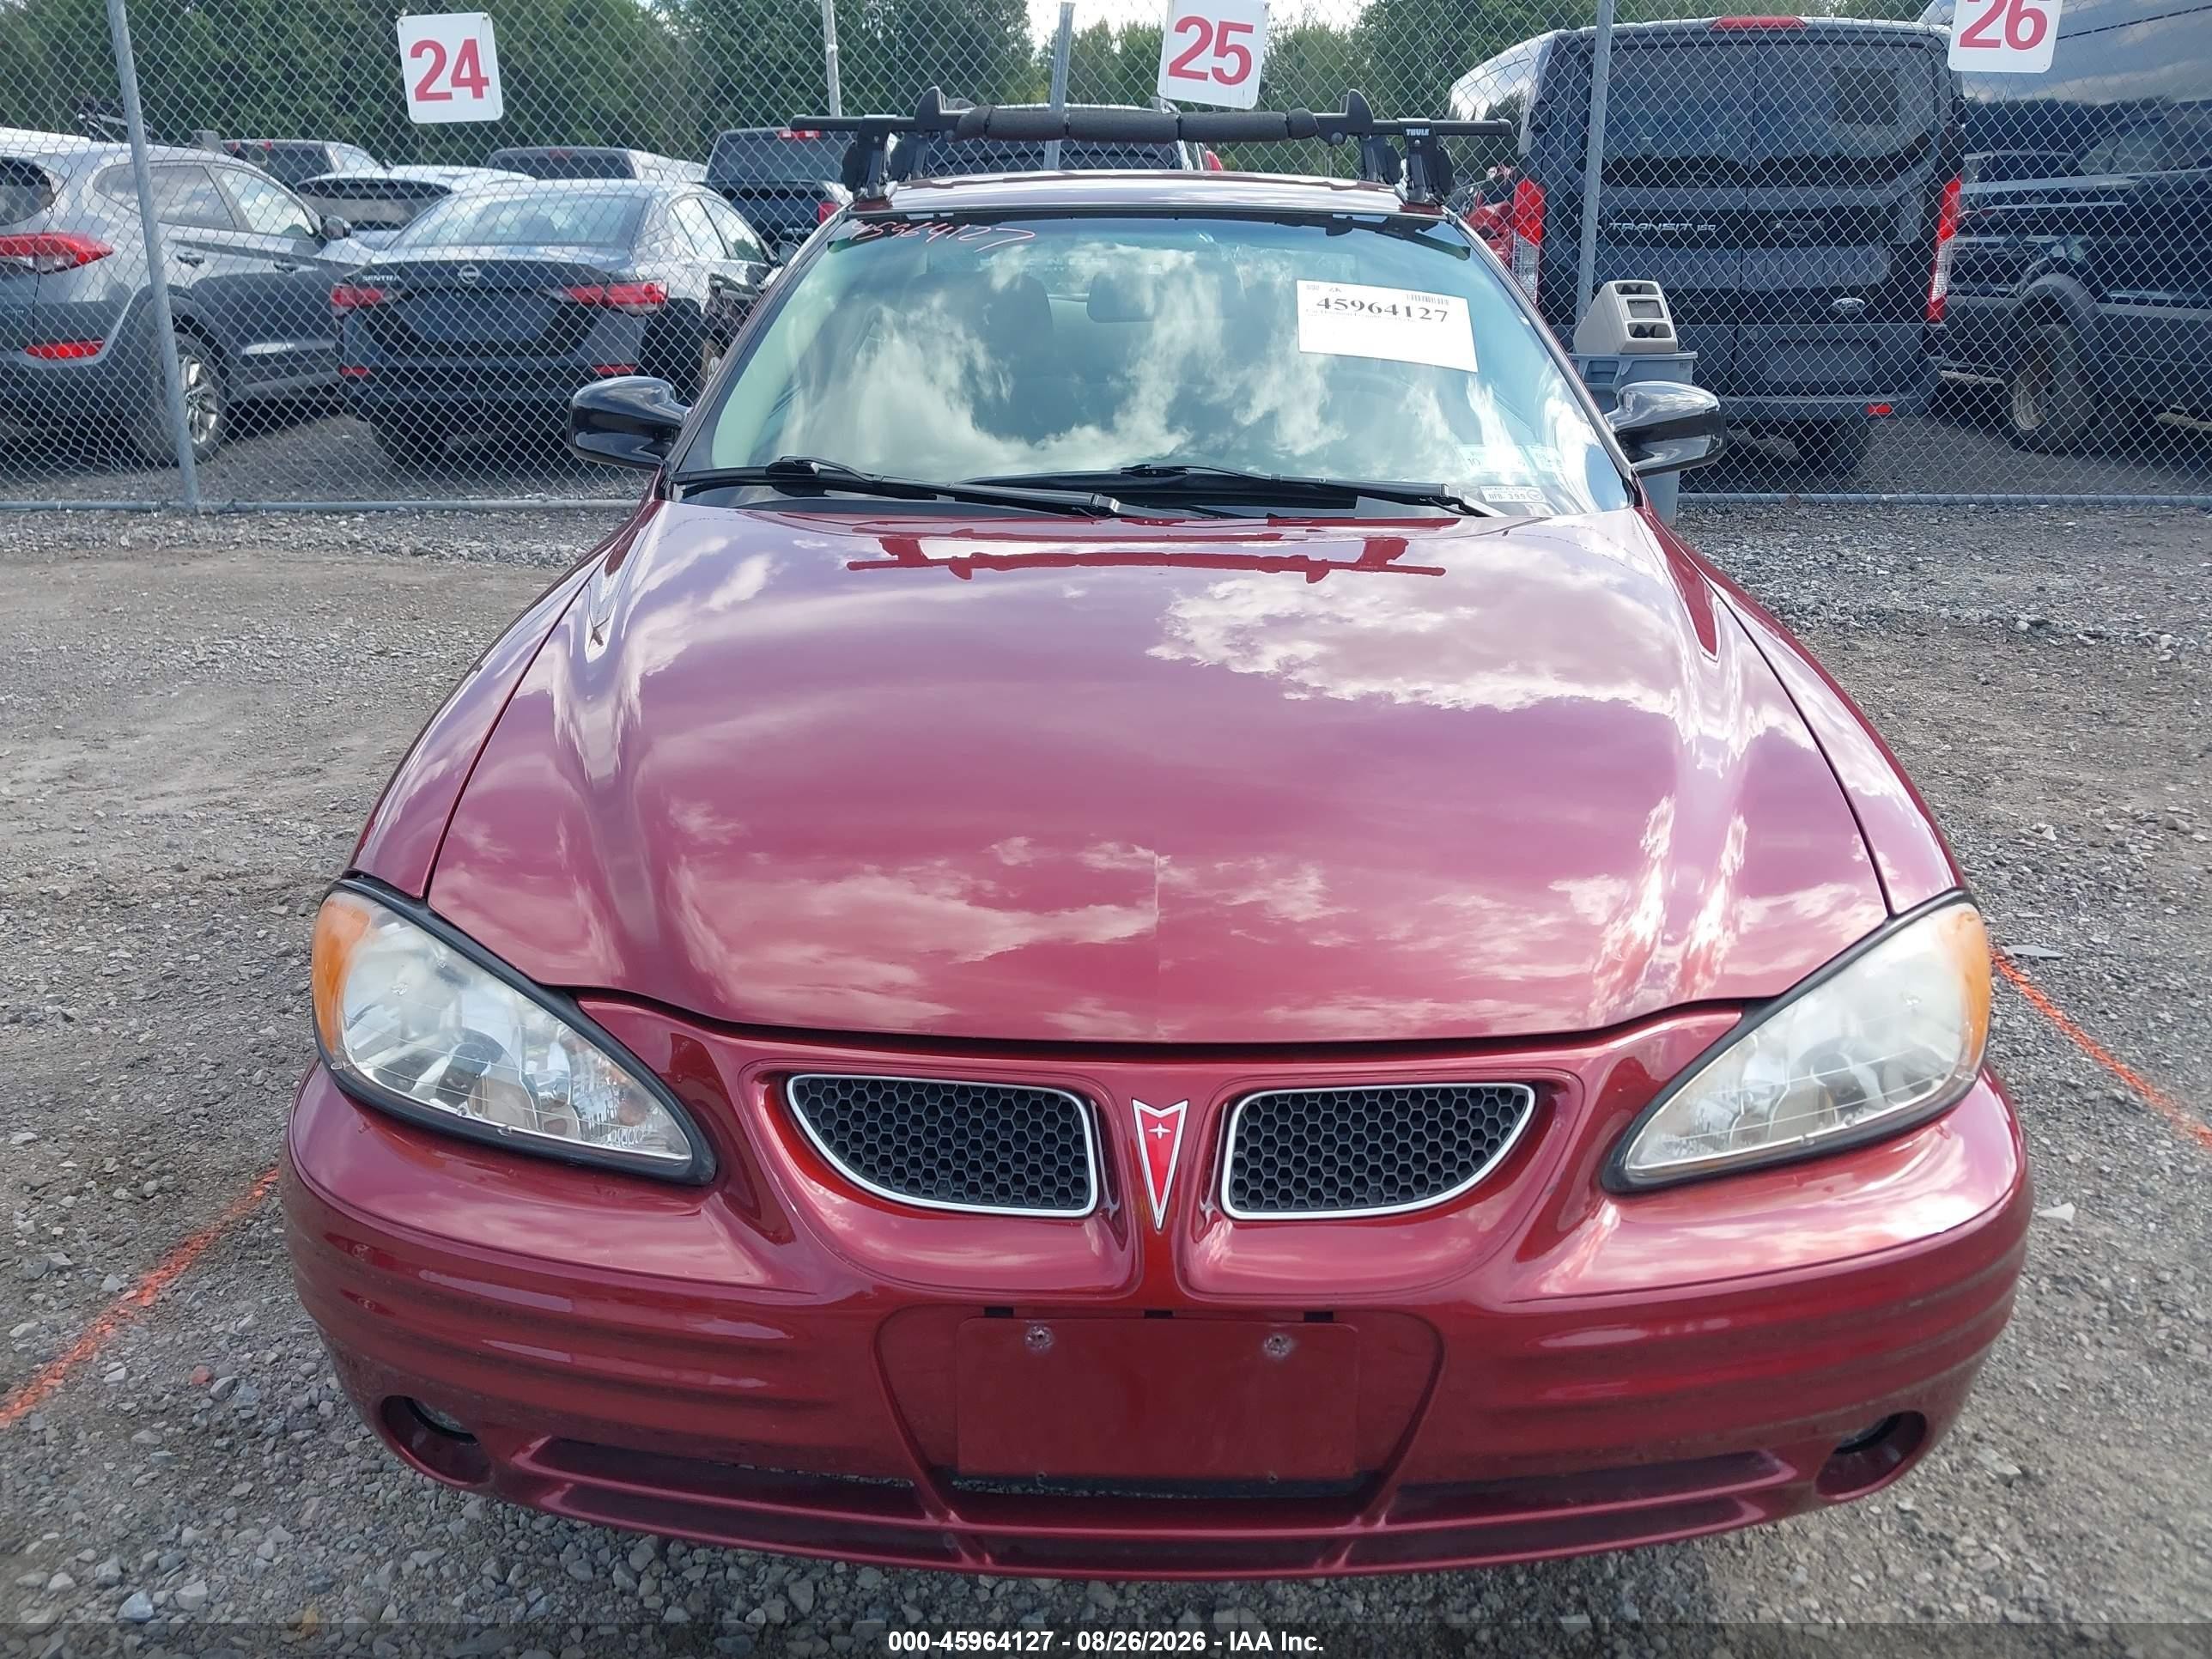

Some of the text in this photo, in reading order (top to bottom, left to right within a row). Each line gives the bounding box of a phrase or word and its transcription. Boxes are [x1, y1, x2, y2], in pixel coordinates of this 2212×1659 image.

[1960, 0, 2047, 51] 26
[1168, 15, 1254, 85] 25
[410, 39, 489, 102] 24
[1405, 128, 1430, 137] THULE
[850, 220, 1036, 253] 45964127
[1609, 222, 1692, 231] TRANSIT
[1316, 297, 1448, 323] 45964127
